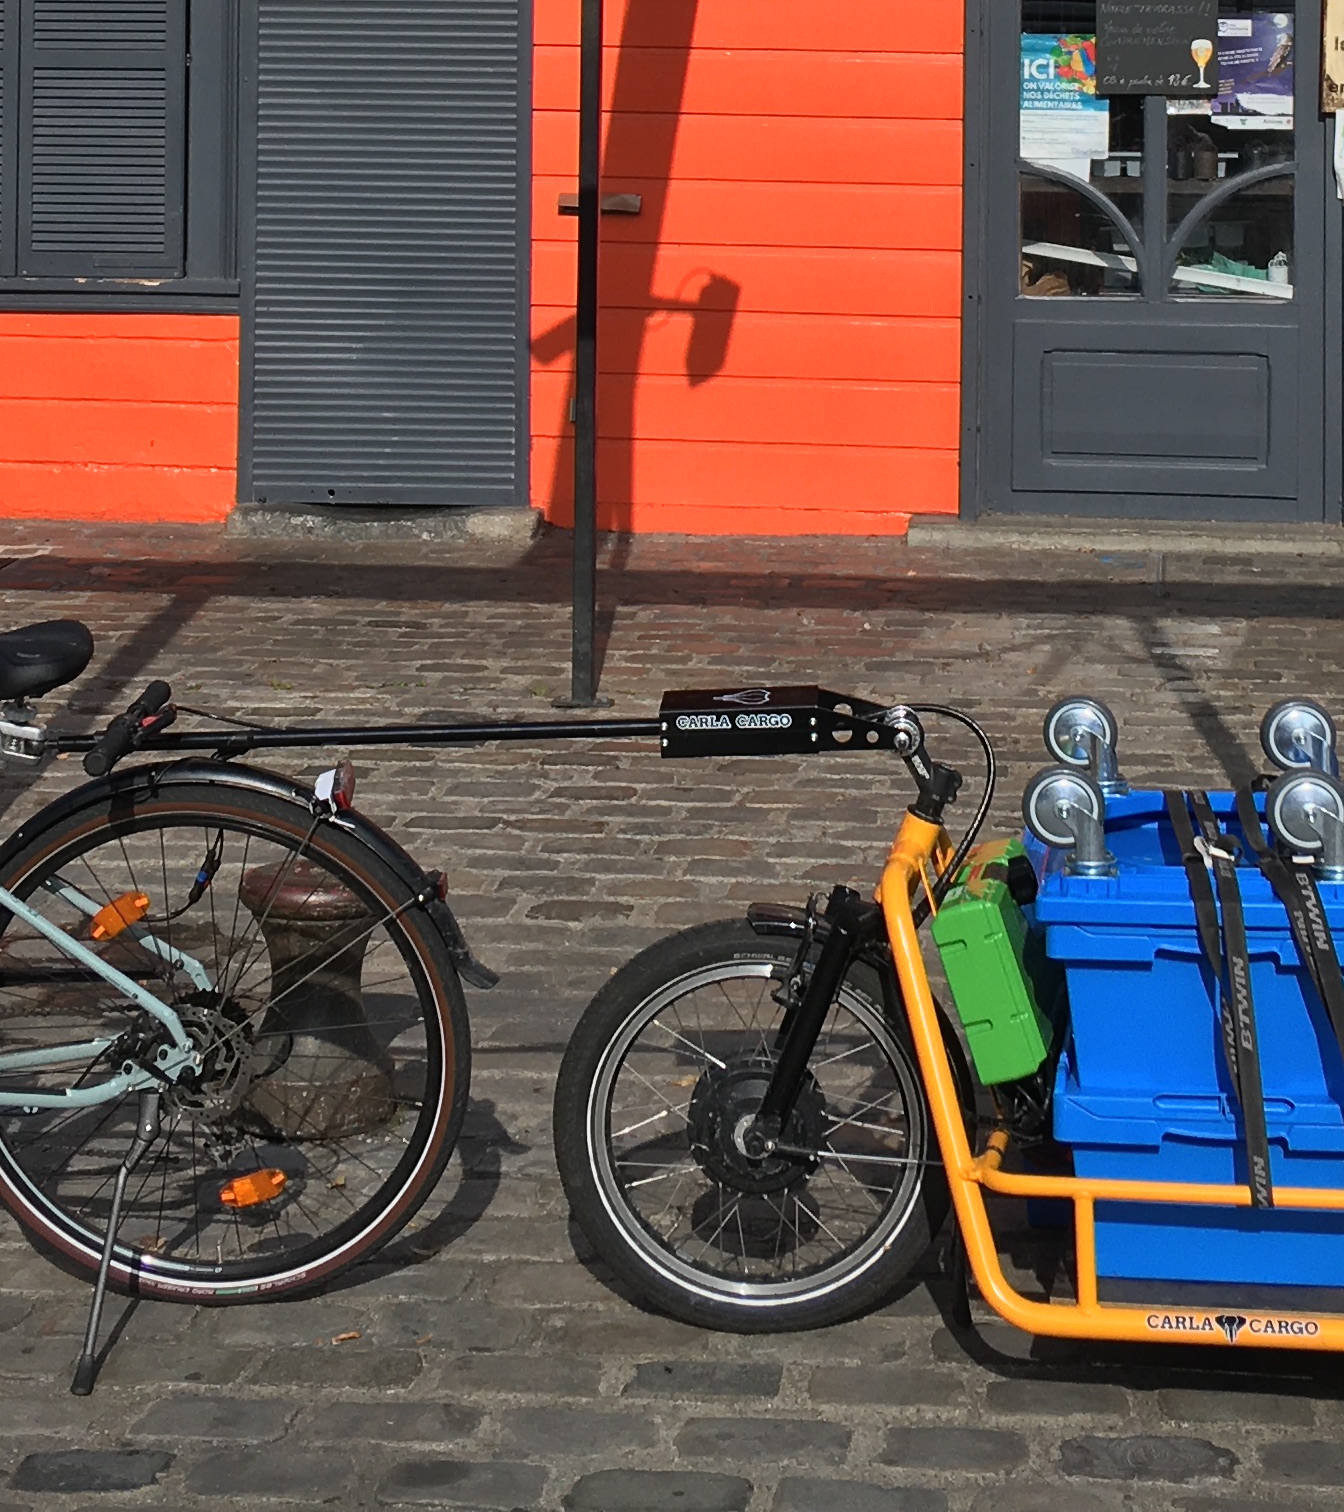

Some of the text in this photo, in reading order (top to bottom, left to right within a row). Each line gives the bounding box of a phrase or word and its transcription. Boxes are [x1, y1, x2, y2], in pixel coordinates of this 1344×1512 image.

[1023, 58, 1056, 80] ICI
[1022, 81, 1080, 91] ON VALORISE
[1022, 90, 1081, 100] NOS DÉCHETS
[1022, 100, 1083, 110] ALIMENTAIRES
[676, 713, 793, 730] CARLA CARGO
[1295, 871, 1330, 952] BTWIN
[1231, 955, 1254, 1053] BTWIN
[1146, 1314, 1320, 1336] CARLA CARGO
